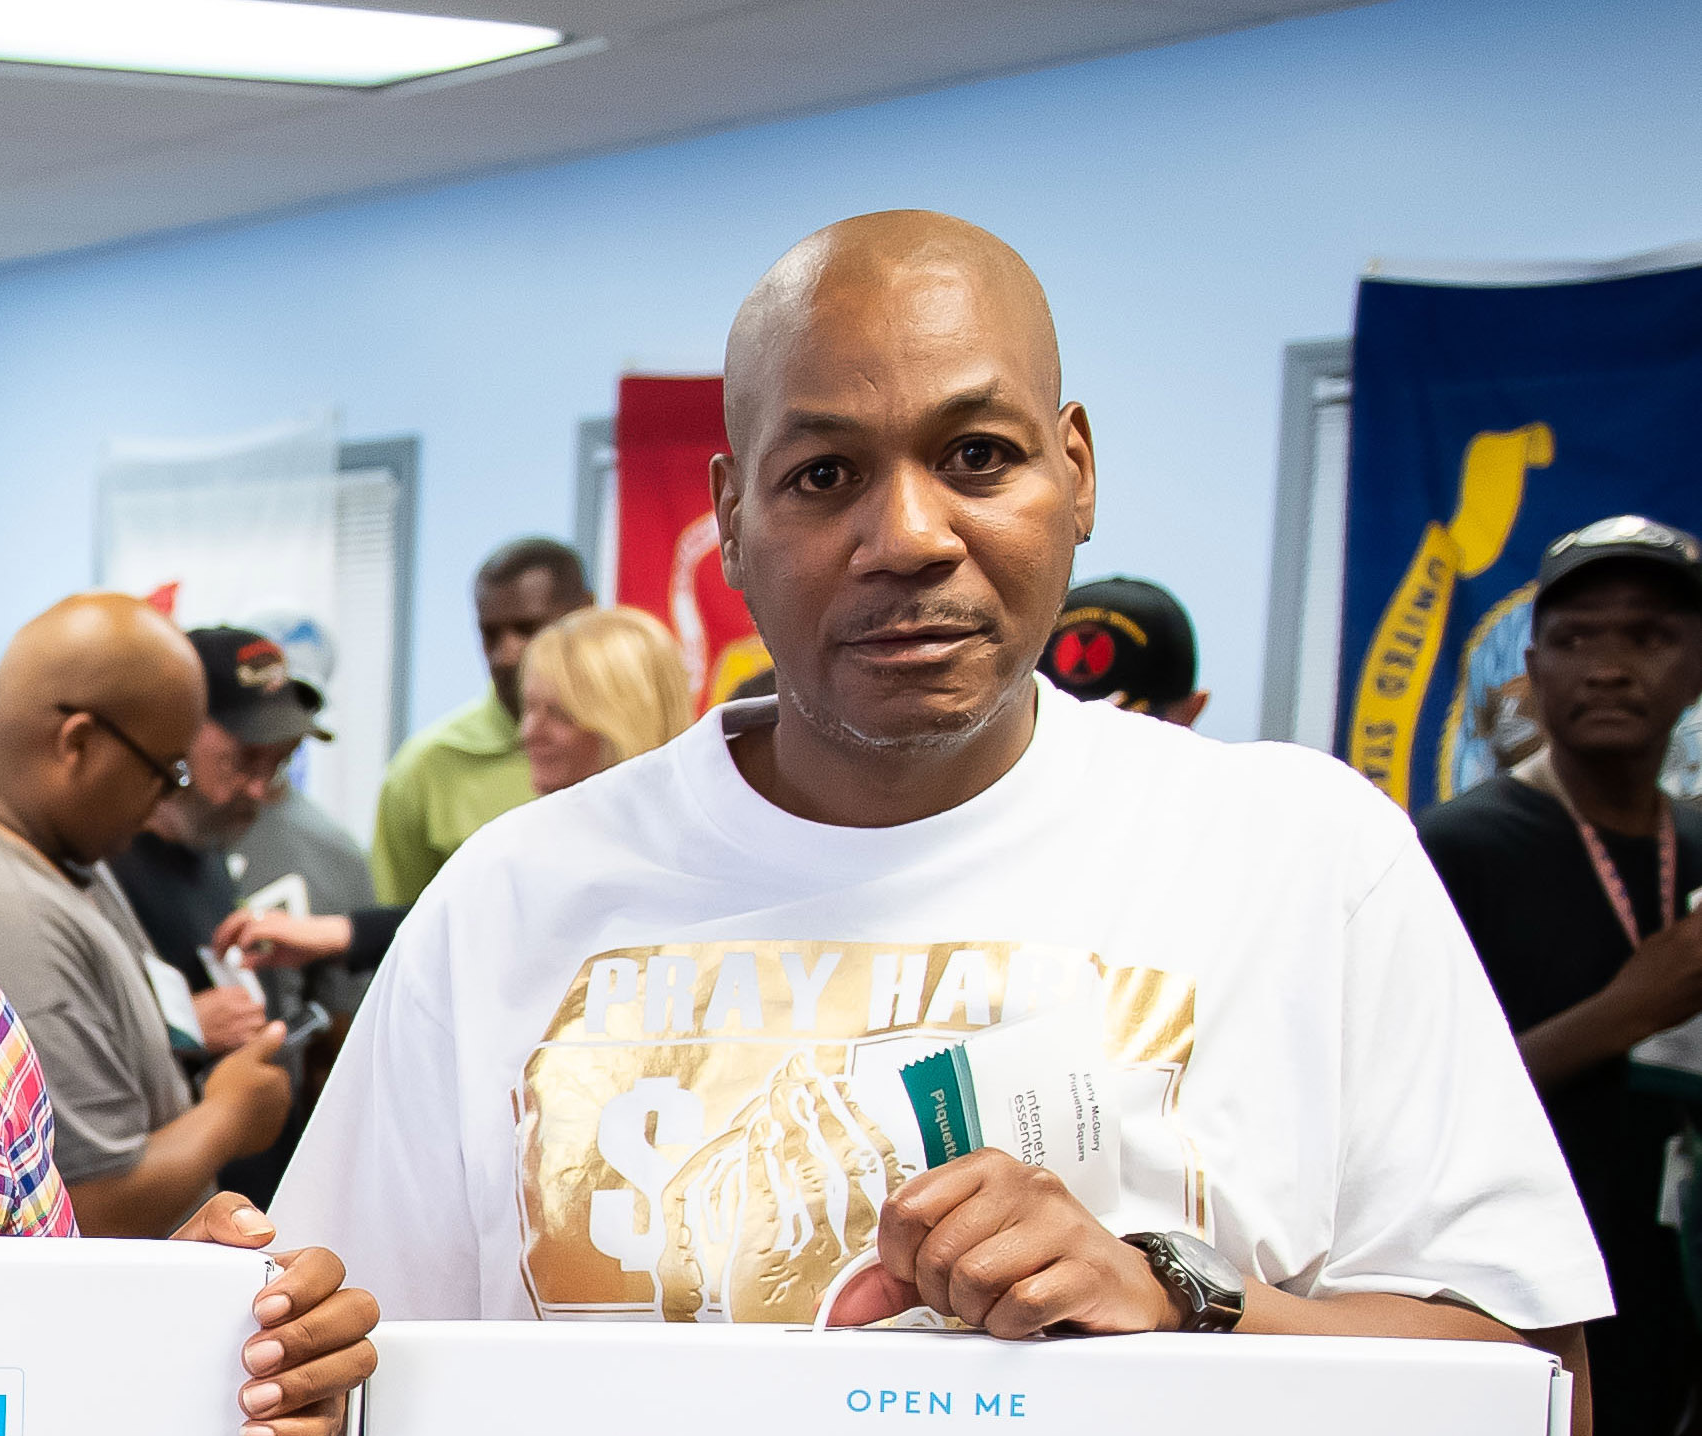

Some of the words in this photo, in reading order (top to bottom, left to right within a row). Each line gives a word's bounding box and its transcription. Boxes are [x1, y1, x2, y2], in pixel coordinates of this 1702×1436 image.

[584, 951, 840, 1035] PRAY
[1026, 1089, 1047, 1157] internet
[1075, 1121, 1086, 1162] Square
[846, 1389, 952, 1415] OPEN
[975, 1392, 1026, 1418] ME
